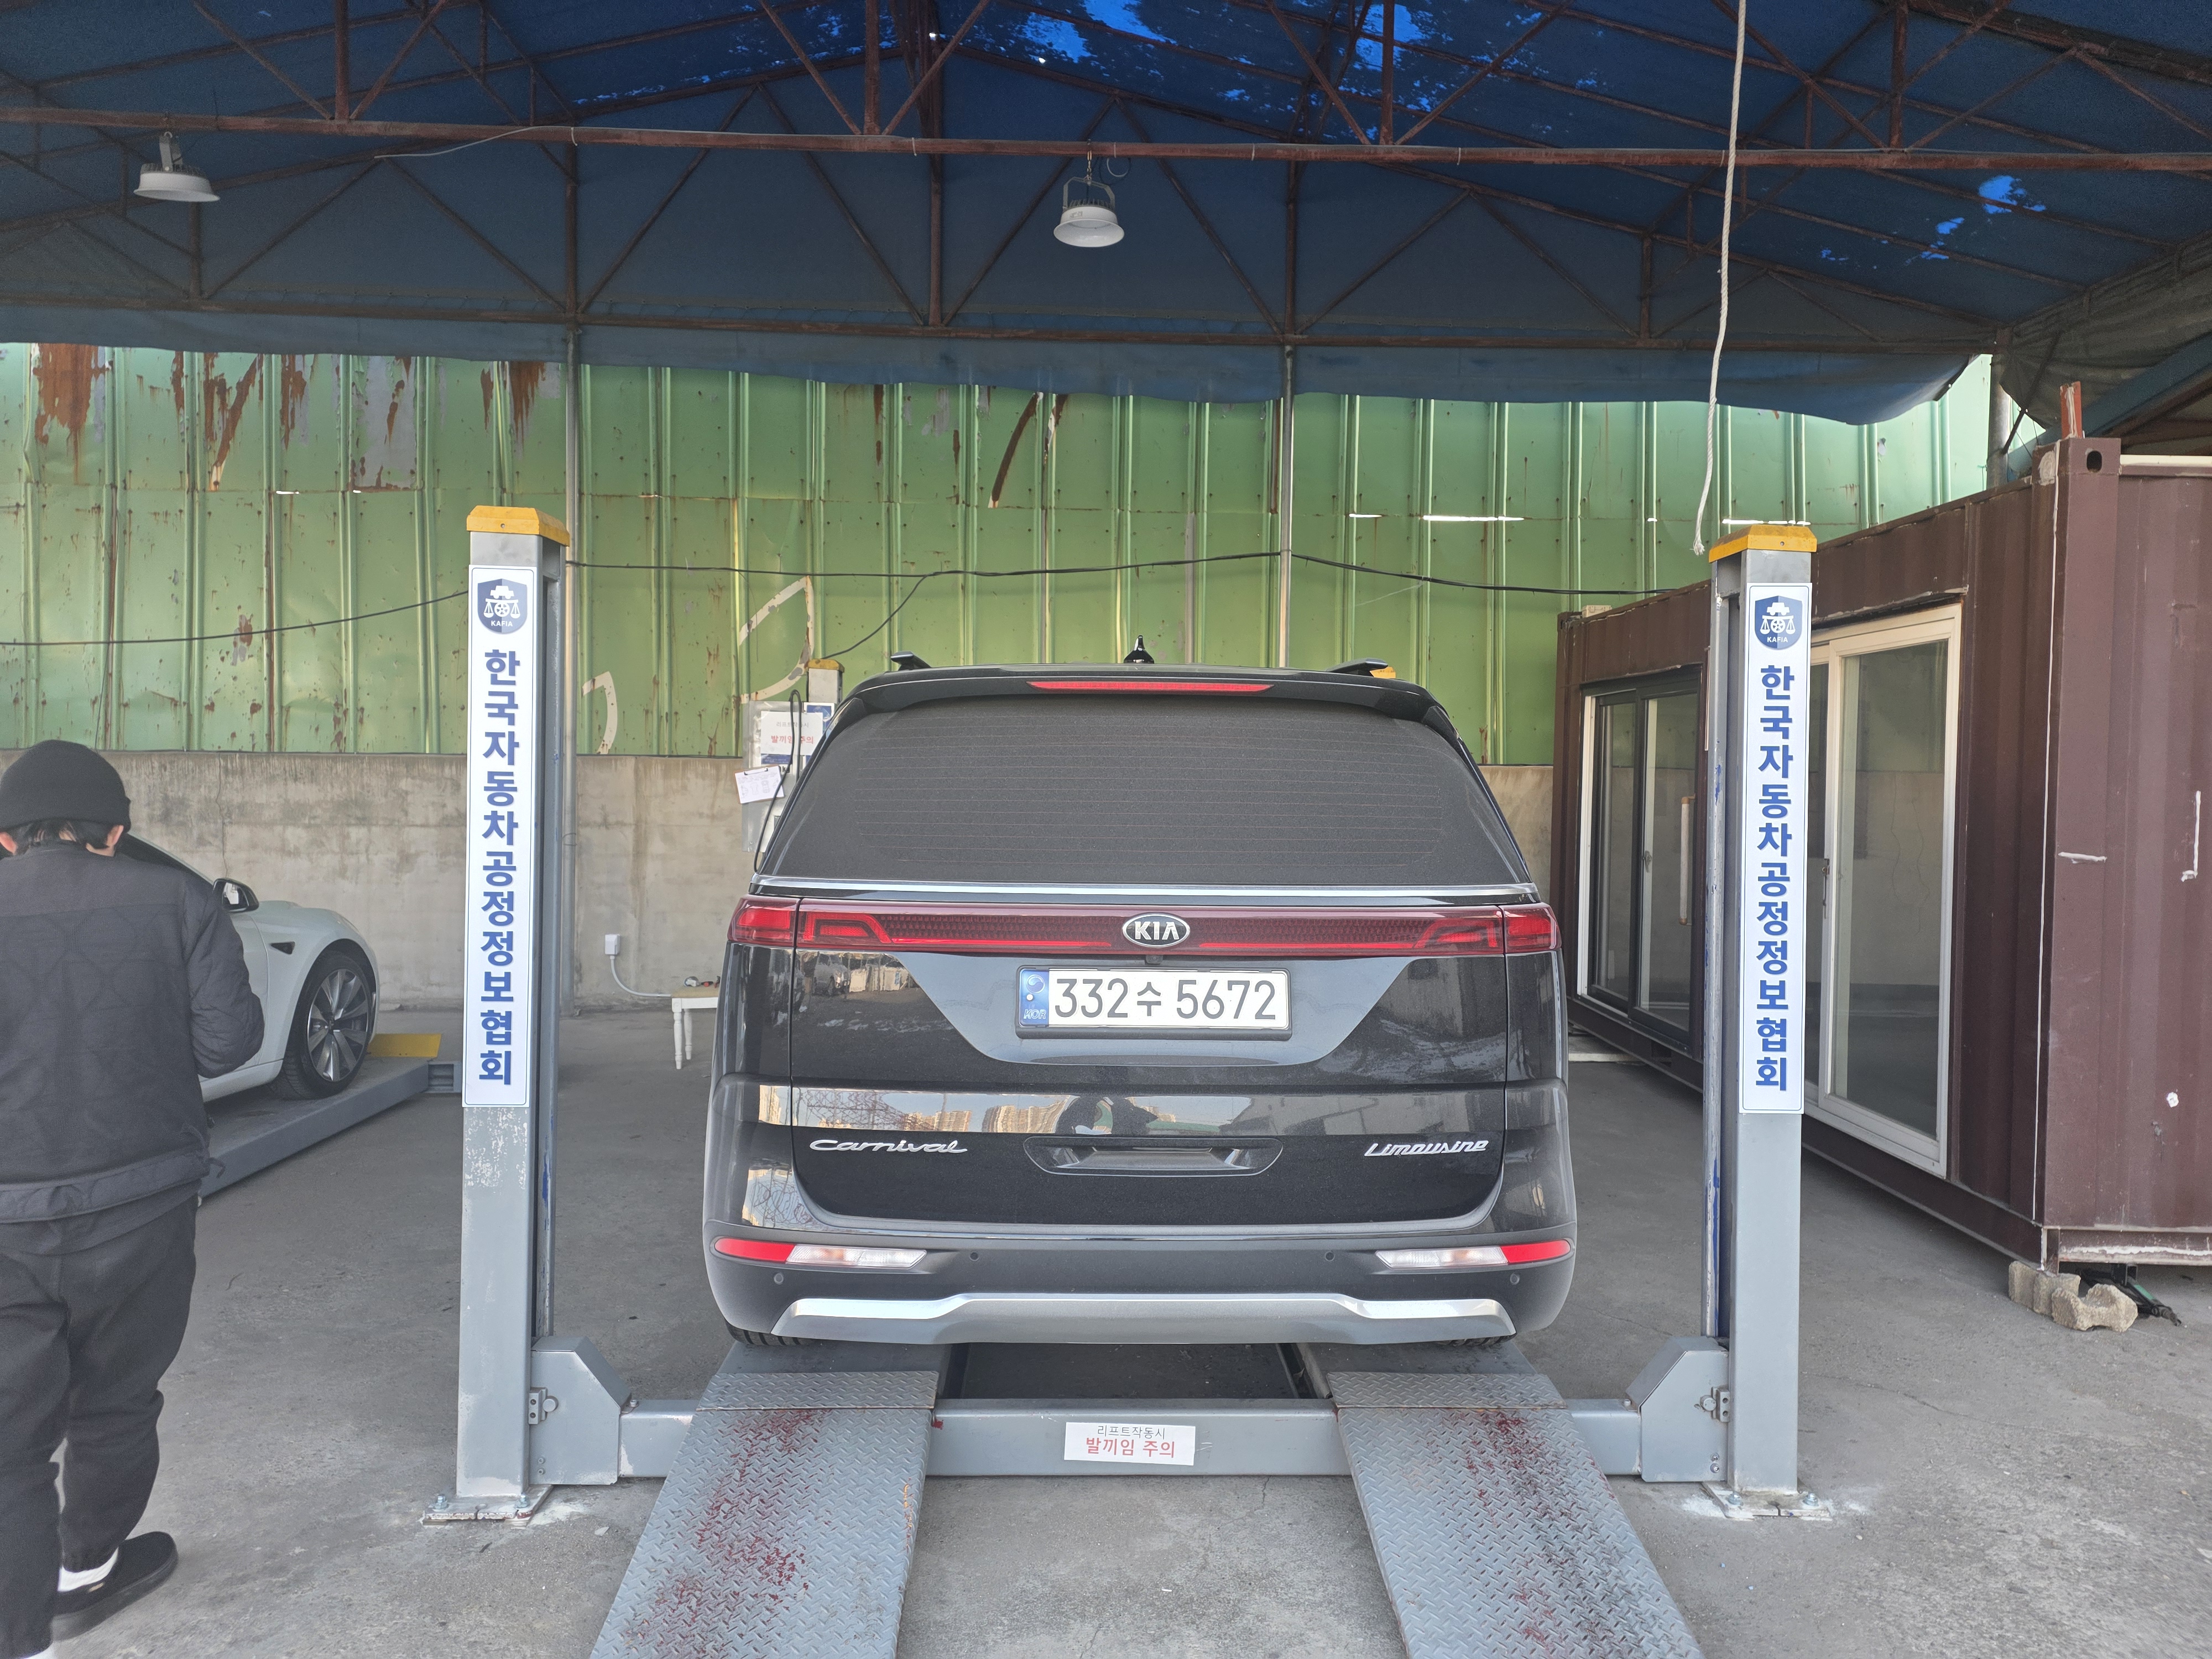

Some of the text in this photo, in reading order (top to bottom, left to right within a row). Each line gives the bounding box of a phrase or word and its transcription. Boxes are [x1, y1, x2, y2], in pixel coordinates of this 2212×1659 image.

[478, 649, 520, 1085] 한국자동차공정정보협회
[1755, 665, 1795, 1091] 한국자동차공정정보협회
[1134, 921, 1180, 940] KIA
[1024, 1009, 1046, 1019] KOR
[810, 1139, 968, 1154] Carnival
[1364, 1140, 1489, 1156] Limousine
[1097, 1425, 1165, 1439] 리프트작동시
[1086, 1437, 1175, 1458] 발끼임 주의
